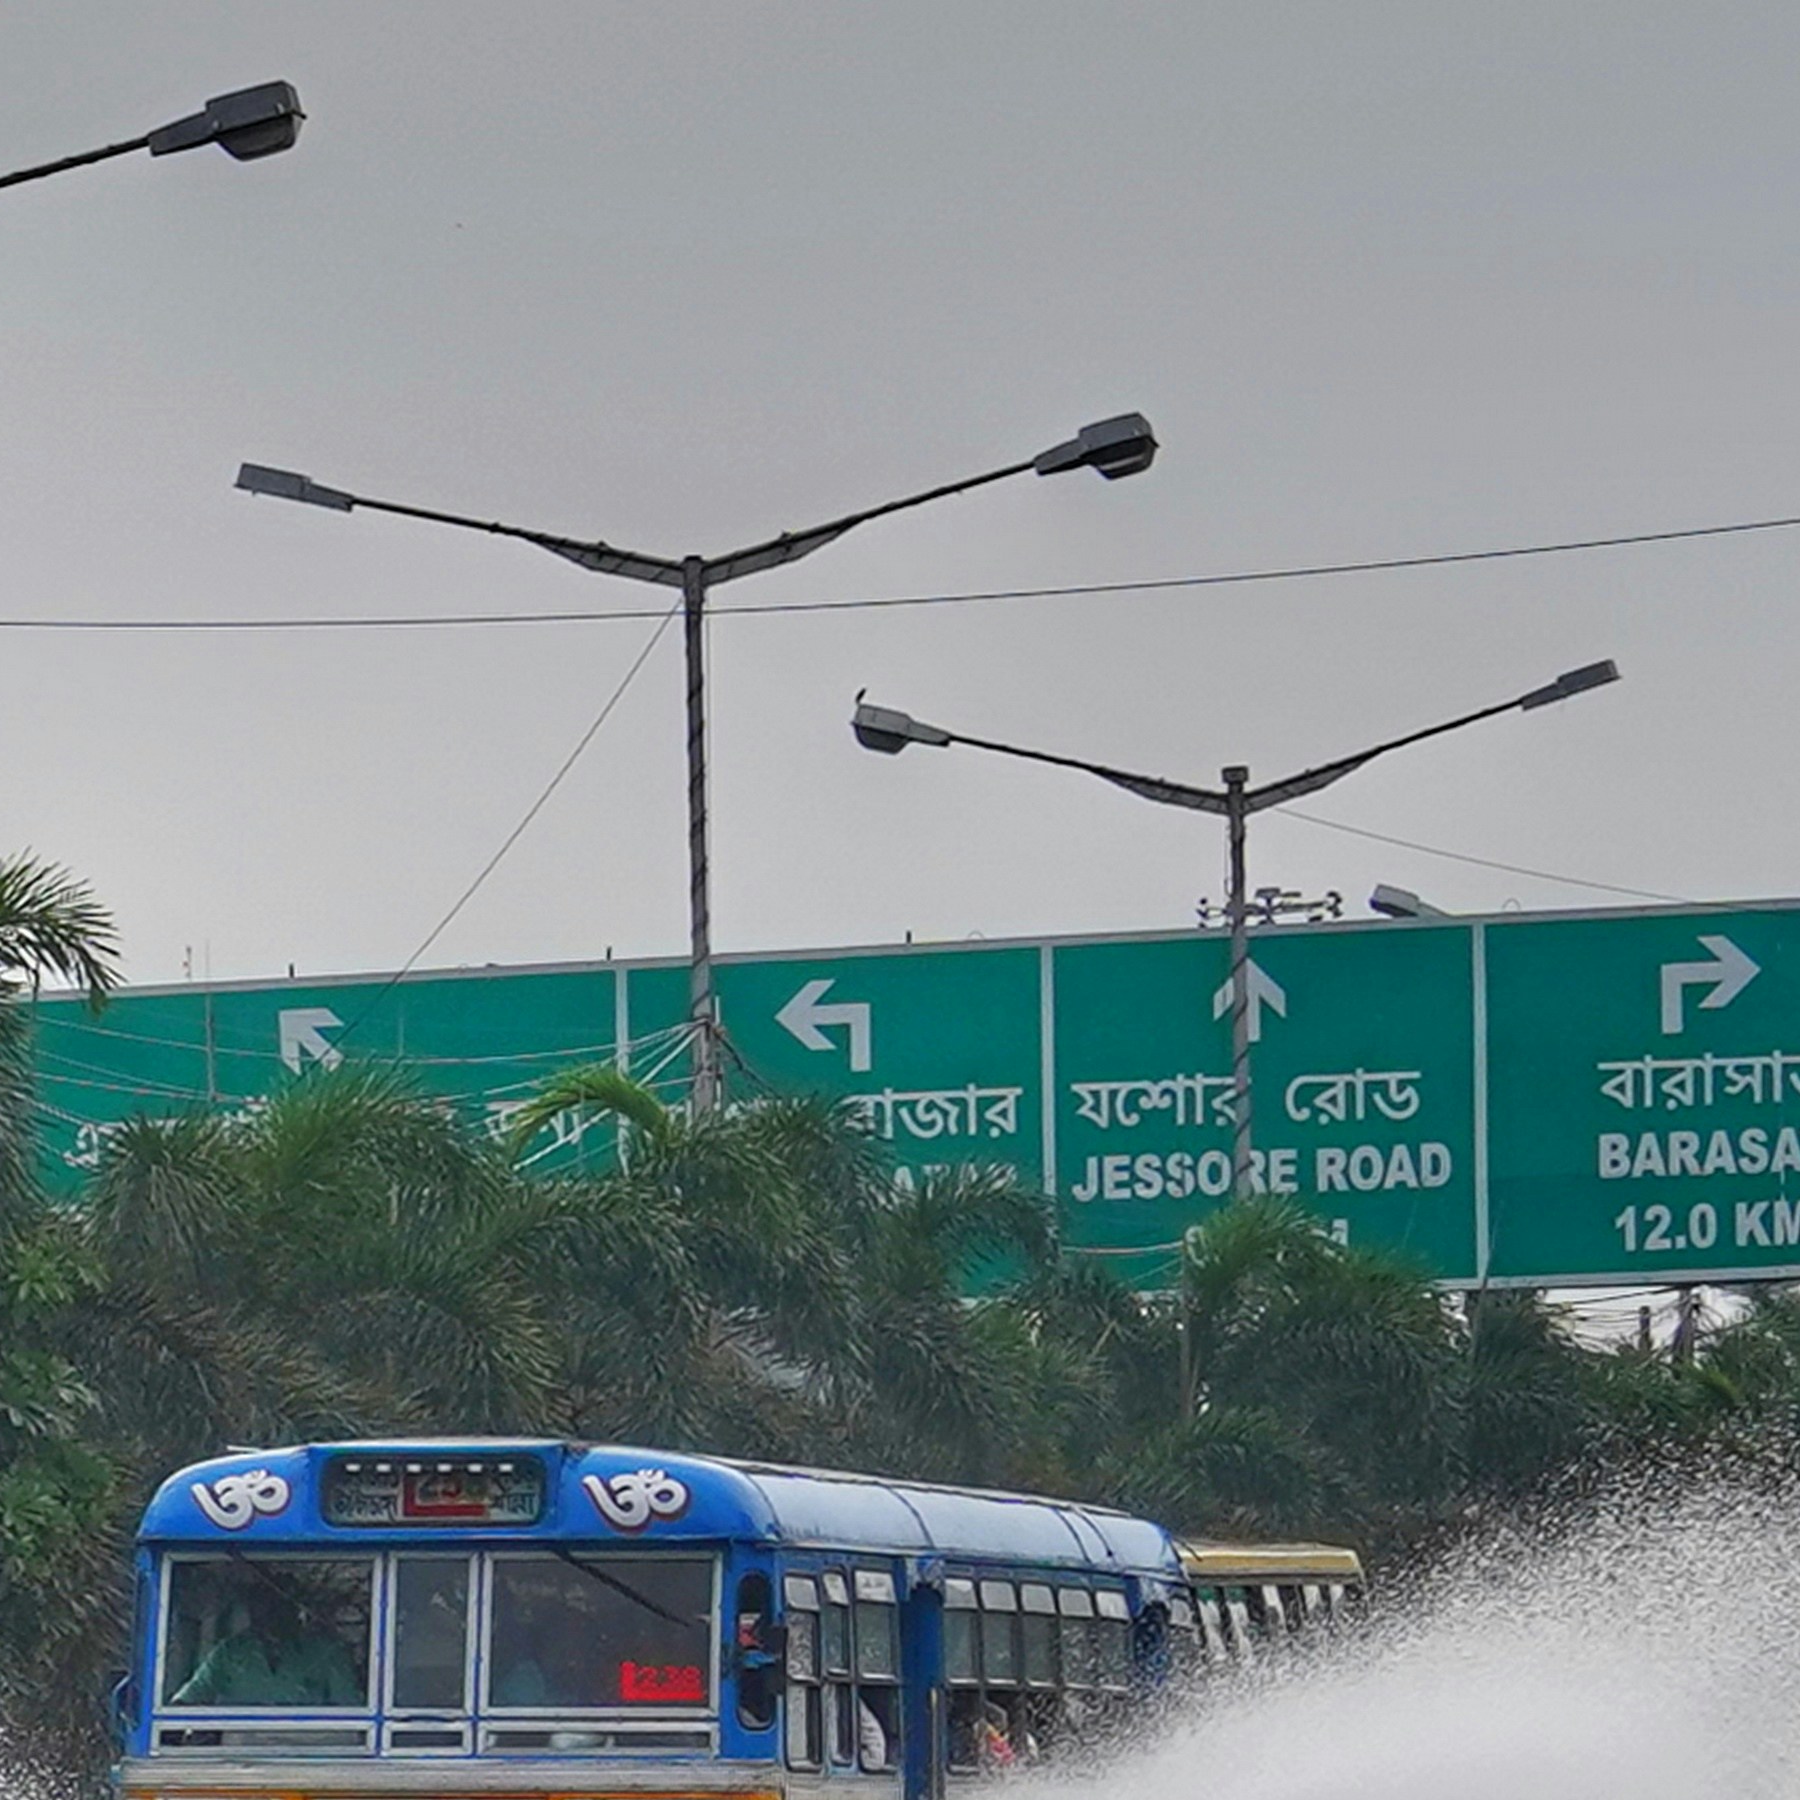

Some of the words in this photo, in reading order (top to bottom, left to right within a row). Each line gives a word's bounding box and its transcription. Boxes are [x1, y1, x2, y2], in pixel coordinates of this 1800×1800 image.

[1285, 1068, 1422, 1124] রোড
[1317, 1142, 1452, 1192] ROAD
[1615, 1203, 1718, 1252] 12.0
